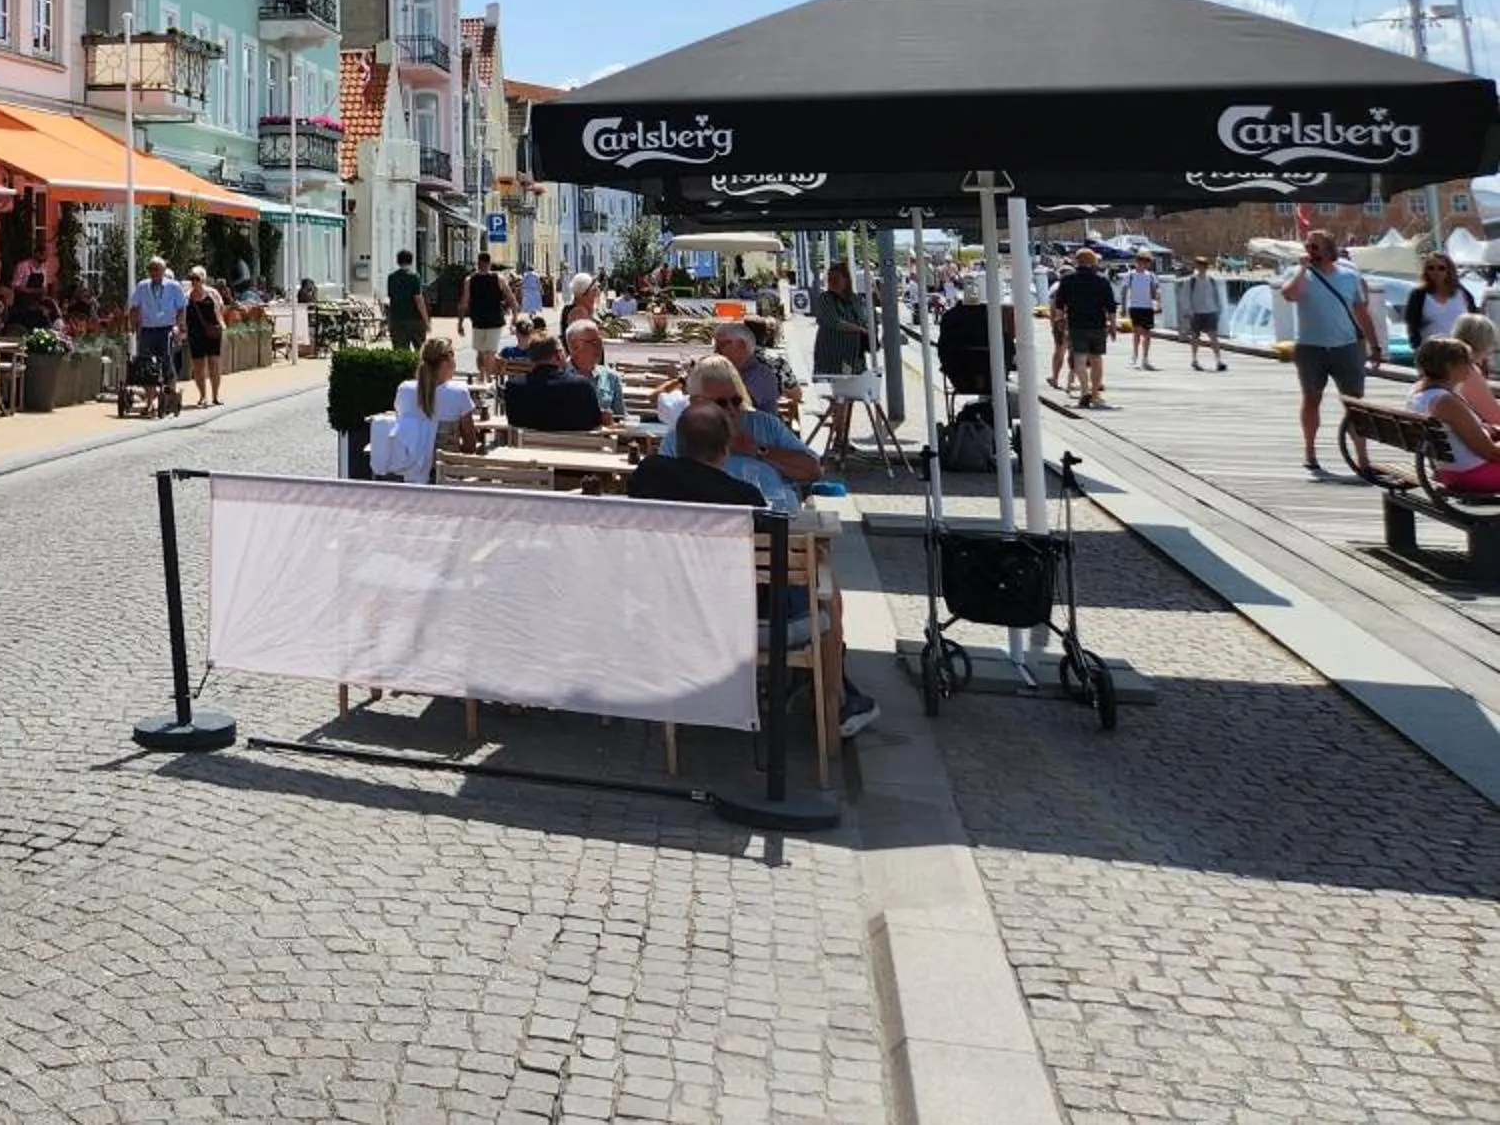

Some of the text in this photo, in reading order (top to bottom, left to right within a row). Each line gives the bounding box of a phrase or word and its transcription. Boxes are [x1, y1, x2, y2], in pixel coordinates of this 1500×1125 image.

[582, 115, 733, 169] Carlsberg
[1217, 105, 1420, 165] Carlsberg
[492, 216, 503, 231] P
